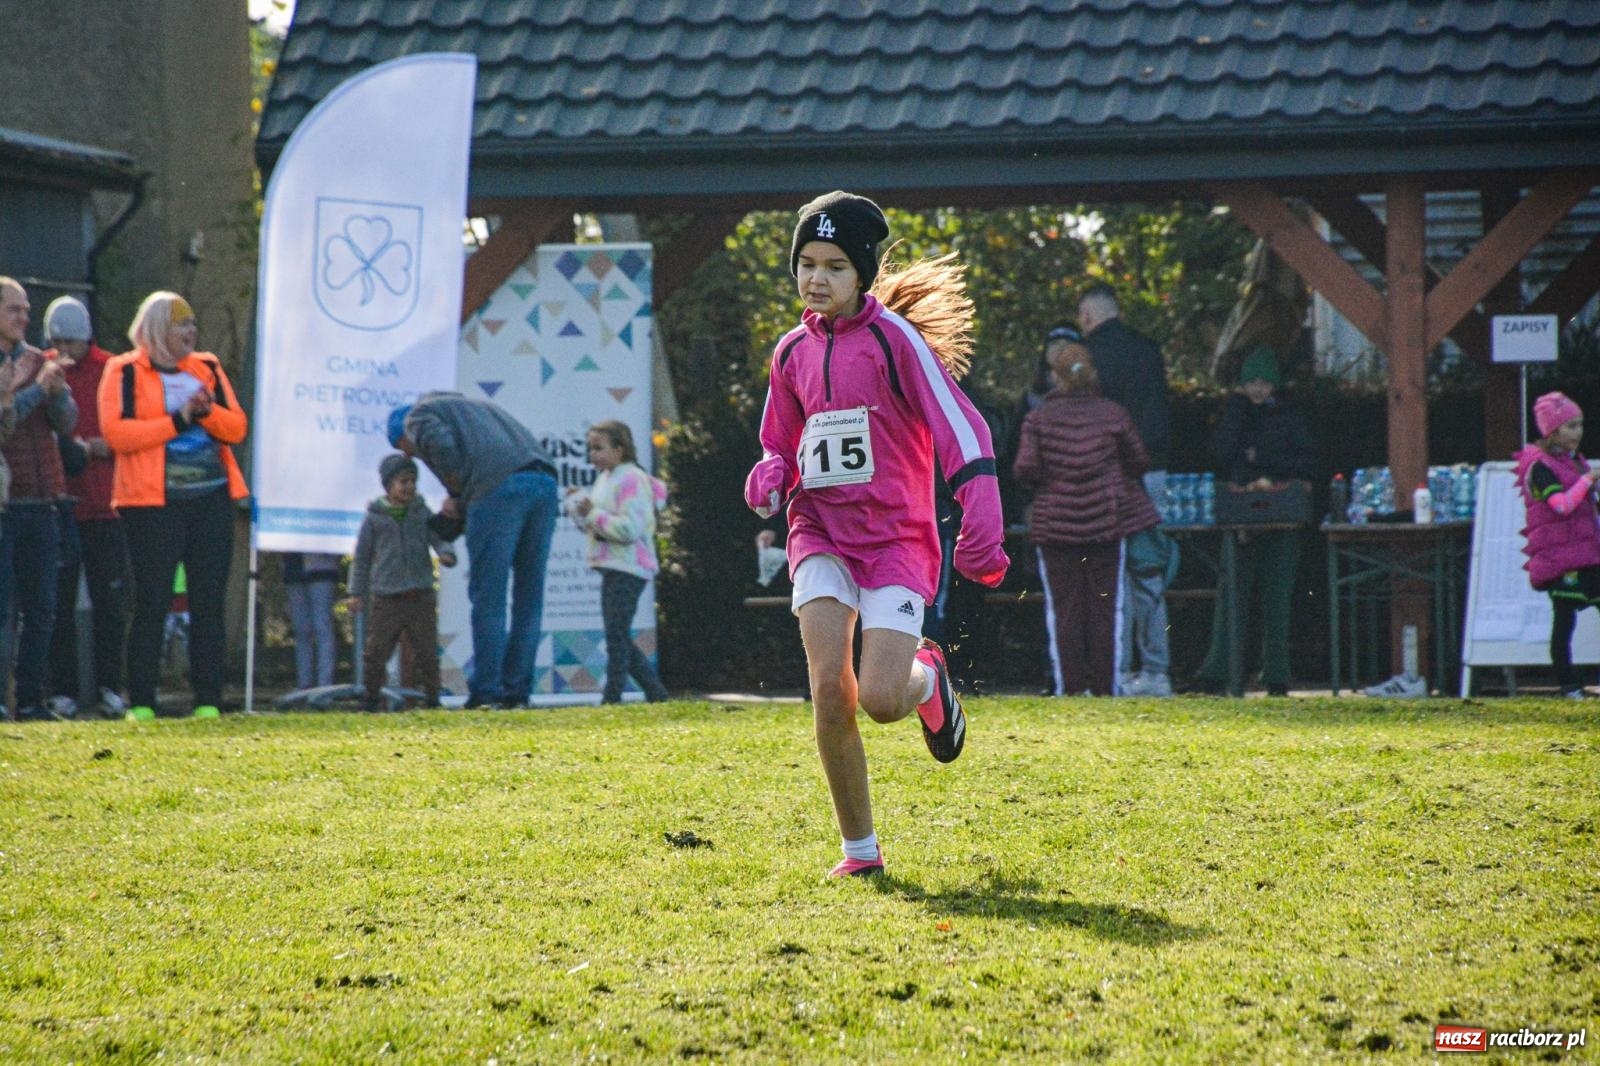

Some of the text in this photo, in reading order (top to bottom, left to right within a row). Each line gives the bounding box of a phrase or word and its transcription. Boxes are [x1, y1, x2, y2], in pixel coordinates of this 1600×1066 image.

[817, 214, 836, 238] LA
[1503, 320, 1549, 334] ZAPISY
[326, 356, 399, 376] GMINA
[295, 384, 417, 406] PIETROWIC
[317, 415, 388, 434] WIELK
